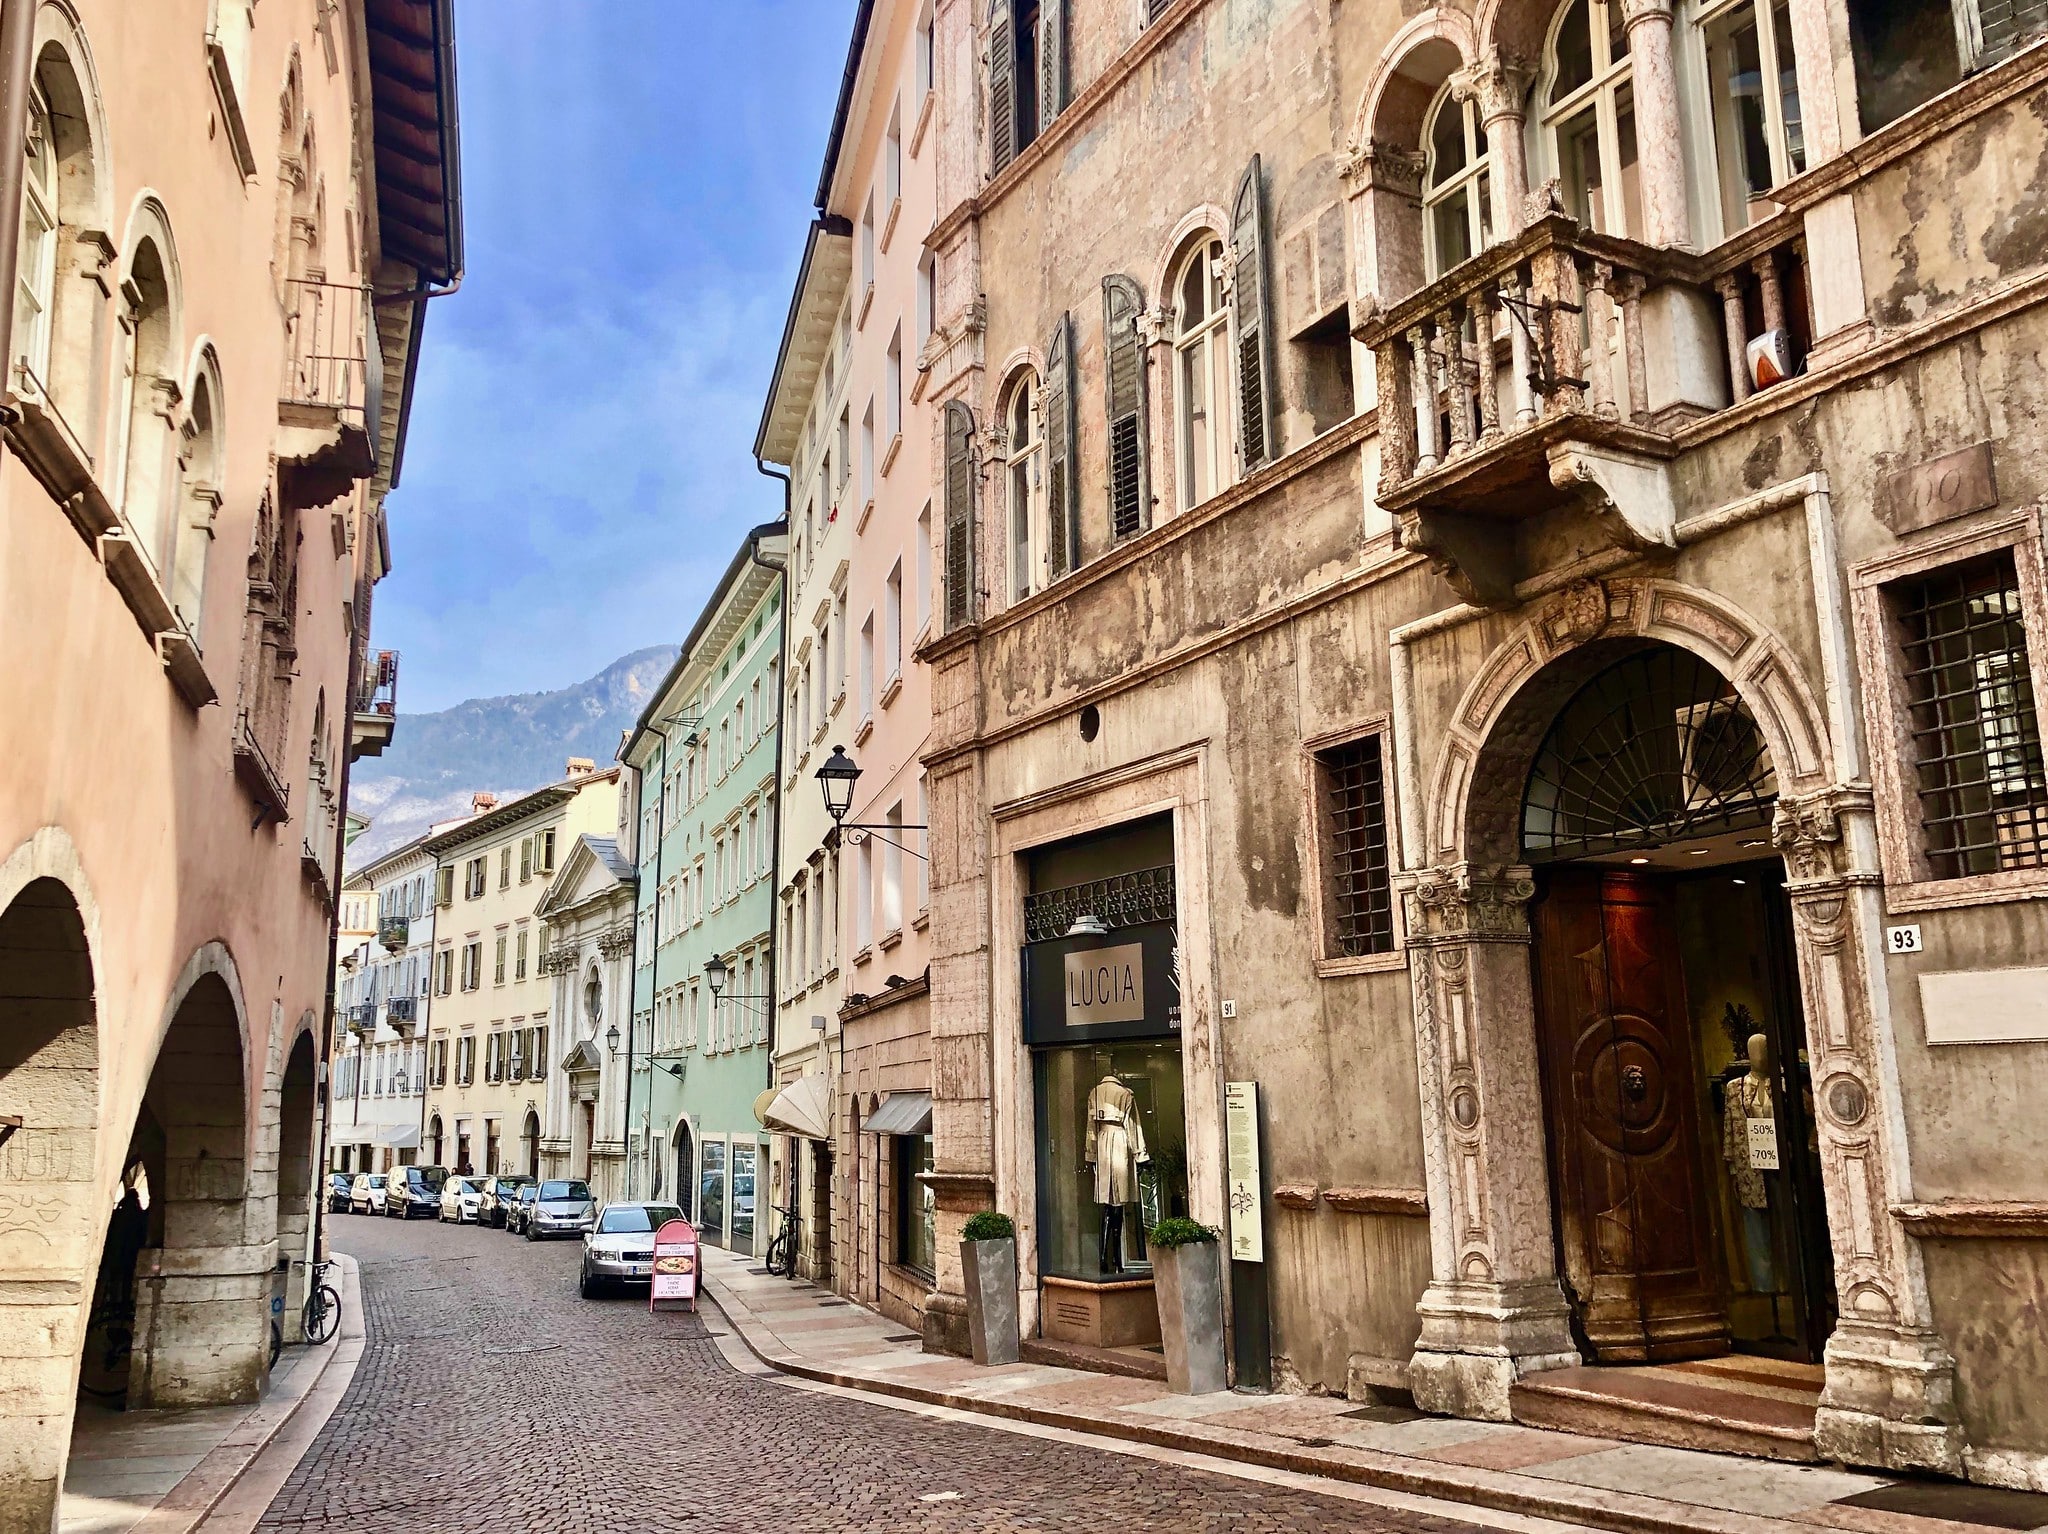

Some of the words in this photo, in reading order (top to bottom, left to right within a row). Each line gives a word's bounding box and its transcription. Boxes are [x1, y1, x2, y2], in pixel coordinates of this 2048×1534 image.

[1893, 929, 1915, 949] 93
[1070, 964, 1135, 1007] LUCIA
[1224, 1002, 1232, 1015] 91
[1750, 1124, 1774, 1135] -50%
[1752, 1149, 1777, 1160] -70%
